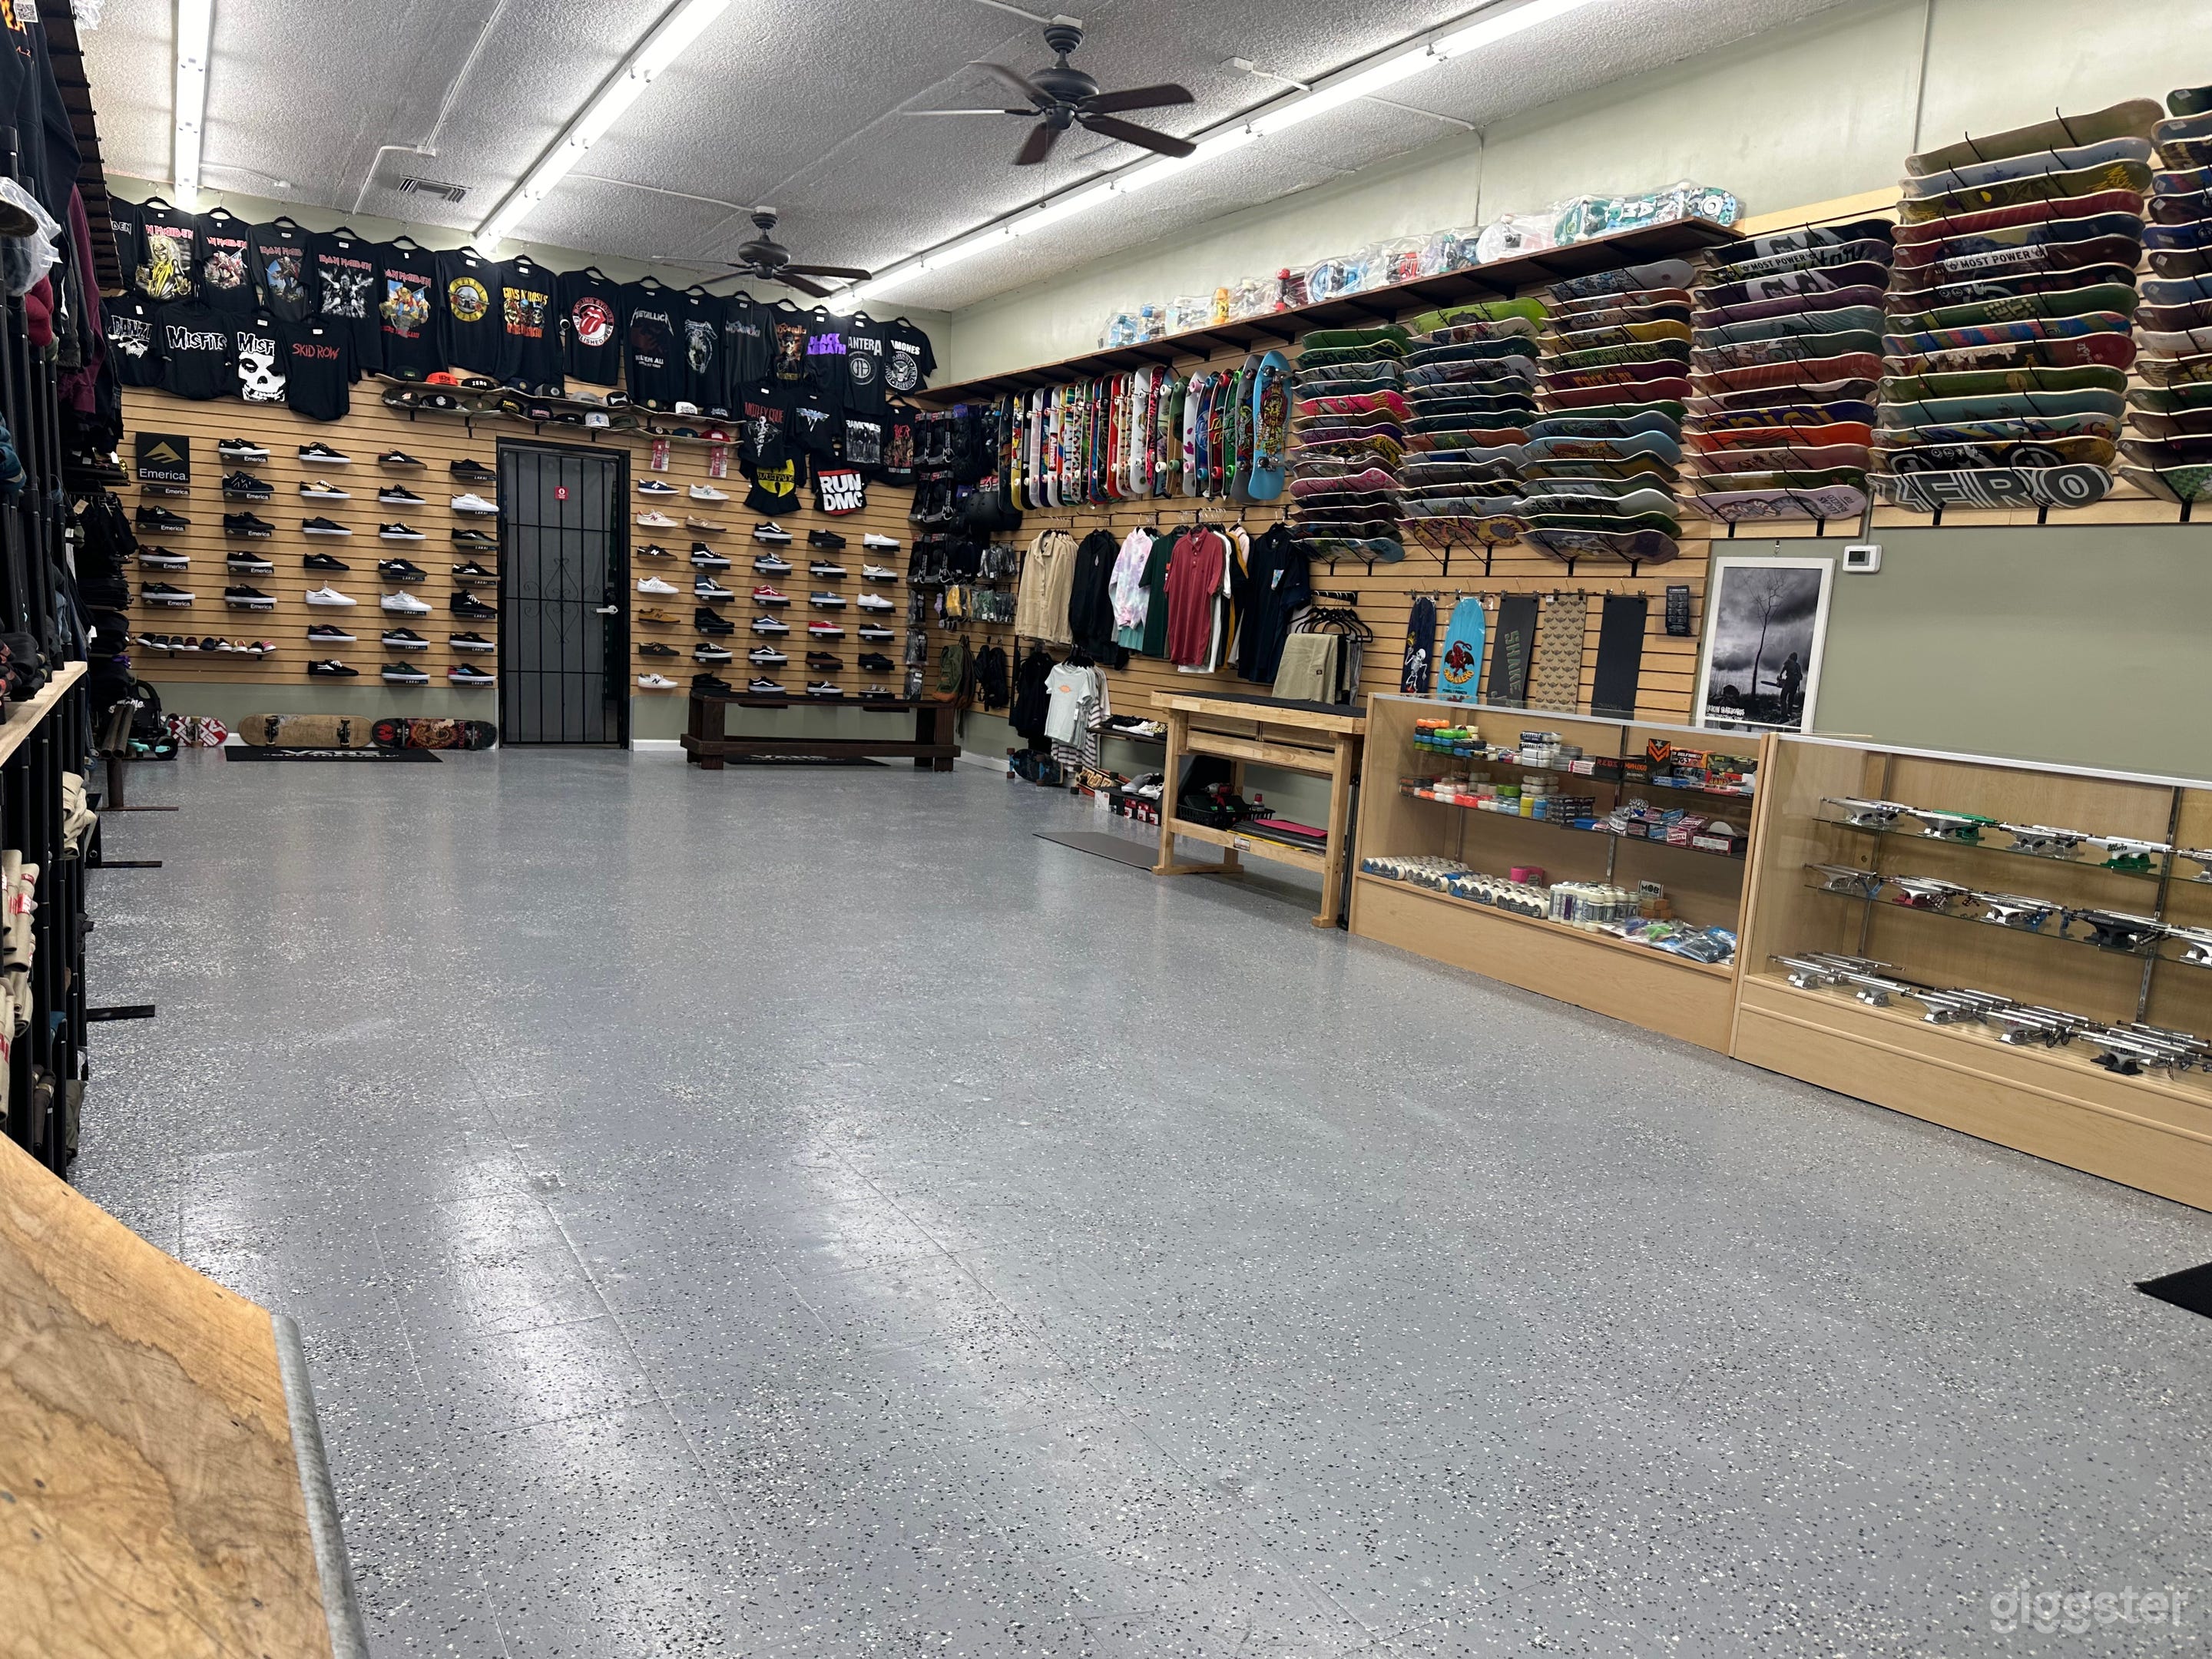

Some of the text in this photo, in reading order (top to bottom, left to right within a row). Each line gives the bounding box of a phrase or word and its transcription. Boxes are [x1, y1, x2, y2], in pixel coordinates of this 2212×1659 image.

[112, 221, 132, 235] DEN
[282, 247, 303, 257] MAID
[1960, 250, 2032, 269] MOST POWER
[319, 254, 372, 273] IRON MAIDEN
[1750, 254, 1806, 270] MOST POWER
[502, 286, 520, 300] GUNS
[528, 290, 548, 306] ROSES
[810, 333, 841, 346] BLACK
[848, 336, 882, 356] ANTERA
[292, 343, 340, 359] SKID ROW
[846, 419, 882, 432] RAMONES
[821, 474, 862, 494] RUN
[823, 492, 864, 512] DMC
[1641, 885, 1661, 894] MOB
